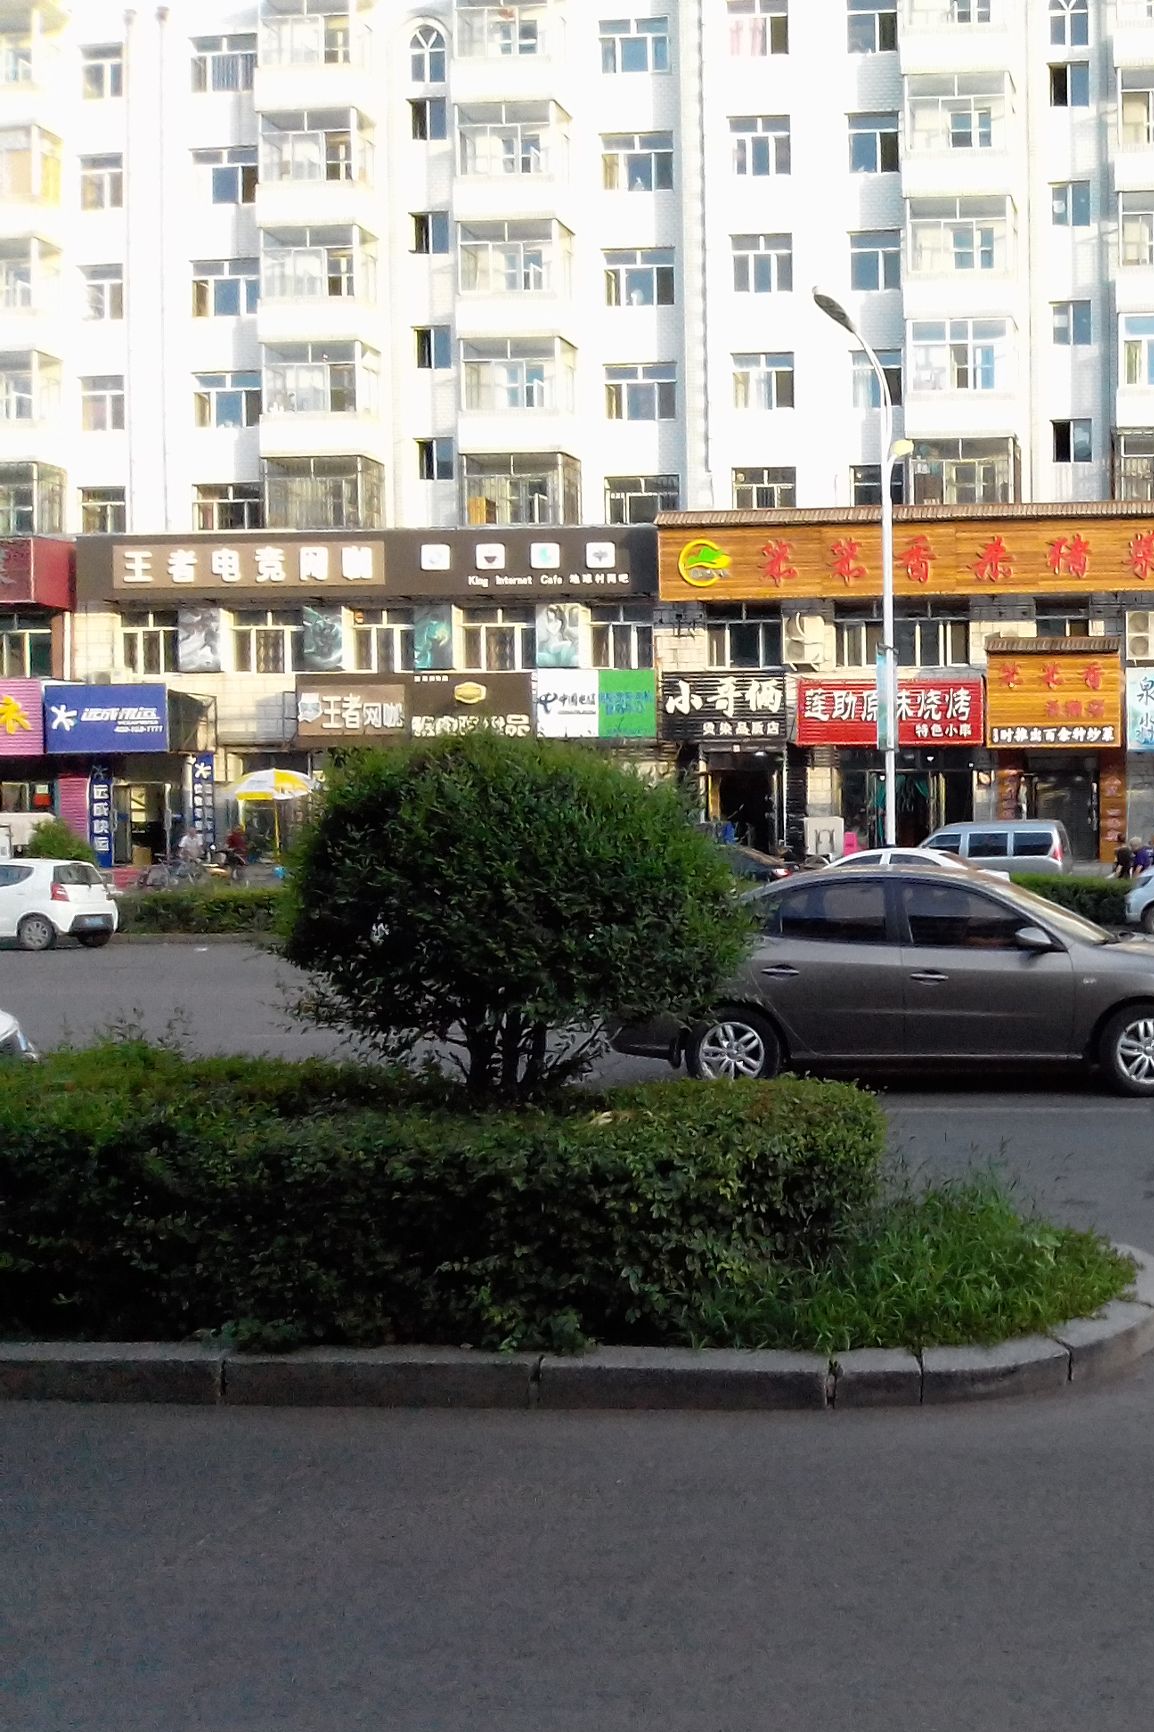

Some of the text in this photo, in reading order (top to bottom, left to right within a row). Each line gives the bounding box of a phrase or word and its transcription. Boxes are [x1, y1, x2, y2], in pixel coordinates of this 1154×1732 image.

[468, 575, 489, 588] King
[495, 574, 533, 585] Internet
[540, 574, 563, 585] Cafe
